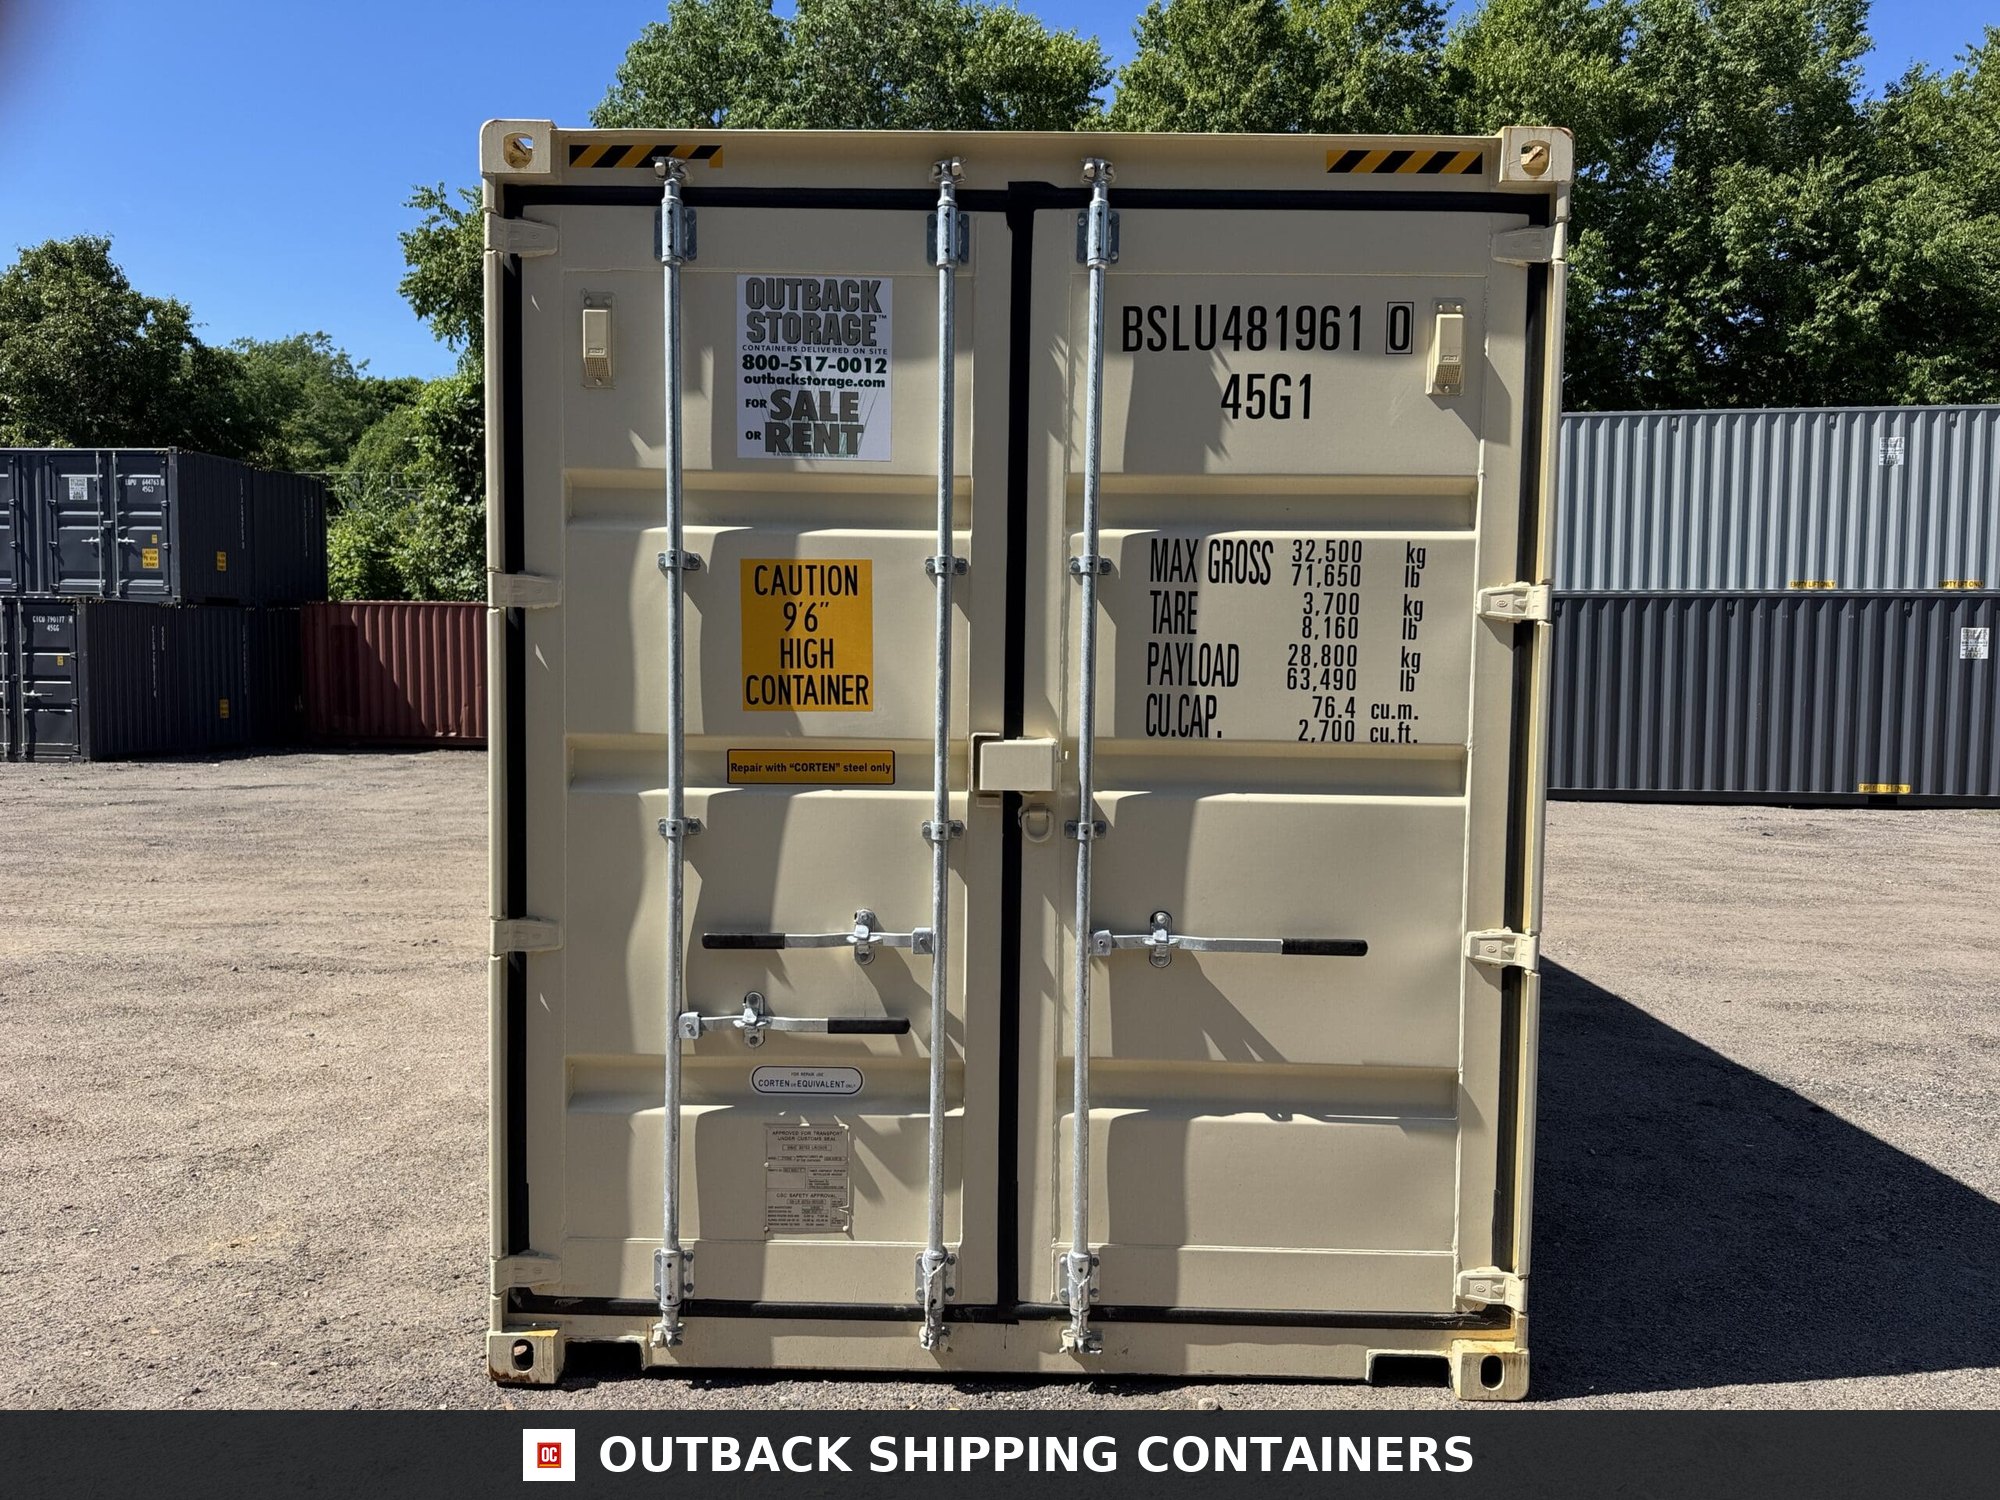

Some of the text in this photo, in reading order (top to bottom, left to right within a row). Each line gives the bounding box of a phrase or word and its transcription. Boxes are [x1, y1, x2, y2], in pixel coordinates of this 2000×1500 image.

[745, 277, 882, 313] OUTBACK
[746, 311, 877, 347] STORAGE
[1122, 303, 1413, 353] BSLU481961 0
[742, 345, 798, 353] CONTAINERS
[801, 346, 849, 354] DELIVERED
[742, 354, 887, 374] 800-517-0012
[743, 372, 885, 388] outbackstorage.com
[745, 389, 859, 422] FOR SALE
[1221, 373, 1312, 419] 45G1
[745, 422, 864, 455] OR RENT
[1150, 538, 1426, 585] MAX GROSS 32,500 kg
[1292, 564, 1420, 588] 71,650 lb
[754, 565, 858, 596] CAUTION
[1150, 590, 1423, 634] TARE 3,700 kg
[1302, 616, 1417, 640] 8,160 lb
[780, 638, 834, 669] HIGH
[1147, 642, 1421, 687] PAYLOAD 28,800 kg
[745, 674, 869, 706] CONTAINER
[1287, 668, 1415, 692] 63,490 lb
[1146, 693, 1419, 738] CU.CAP. 76.4 cu.m.
[1298, 720, 1418, 743] 2,700 cu.ft.
[731, 763, 762, 774] Repair
[765, 763, 787, 772] with
[843, 763, 867, 772] steel
[870, 763, 891, 774] only
[758, 1079, 790, 1087] CORTEN
[797, 1079, 845, 1088] EQUIVALENT
